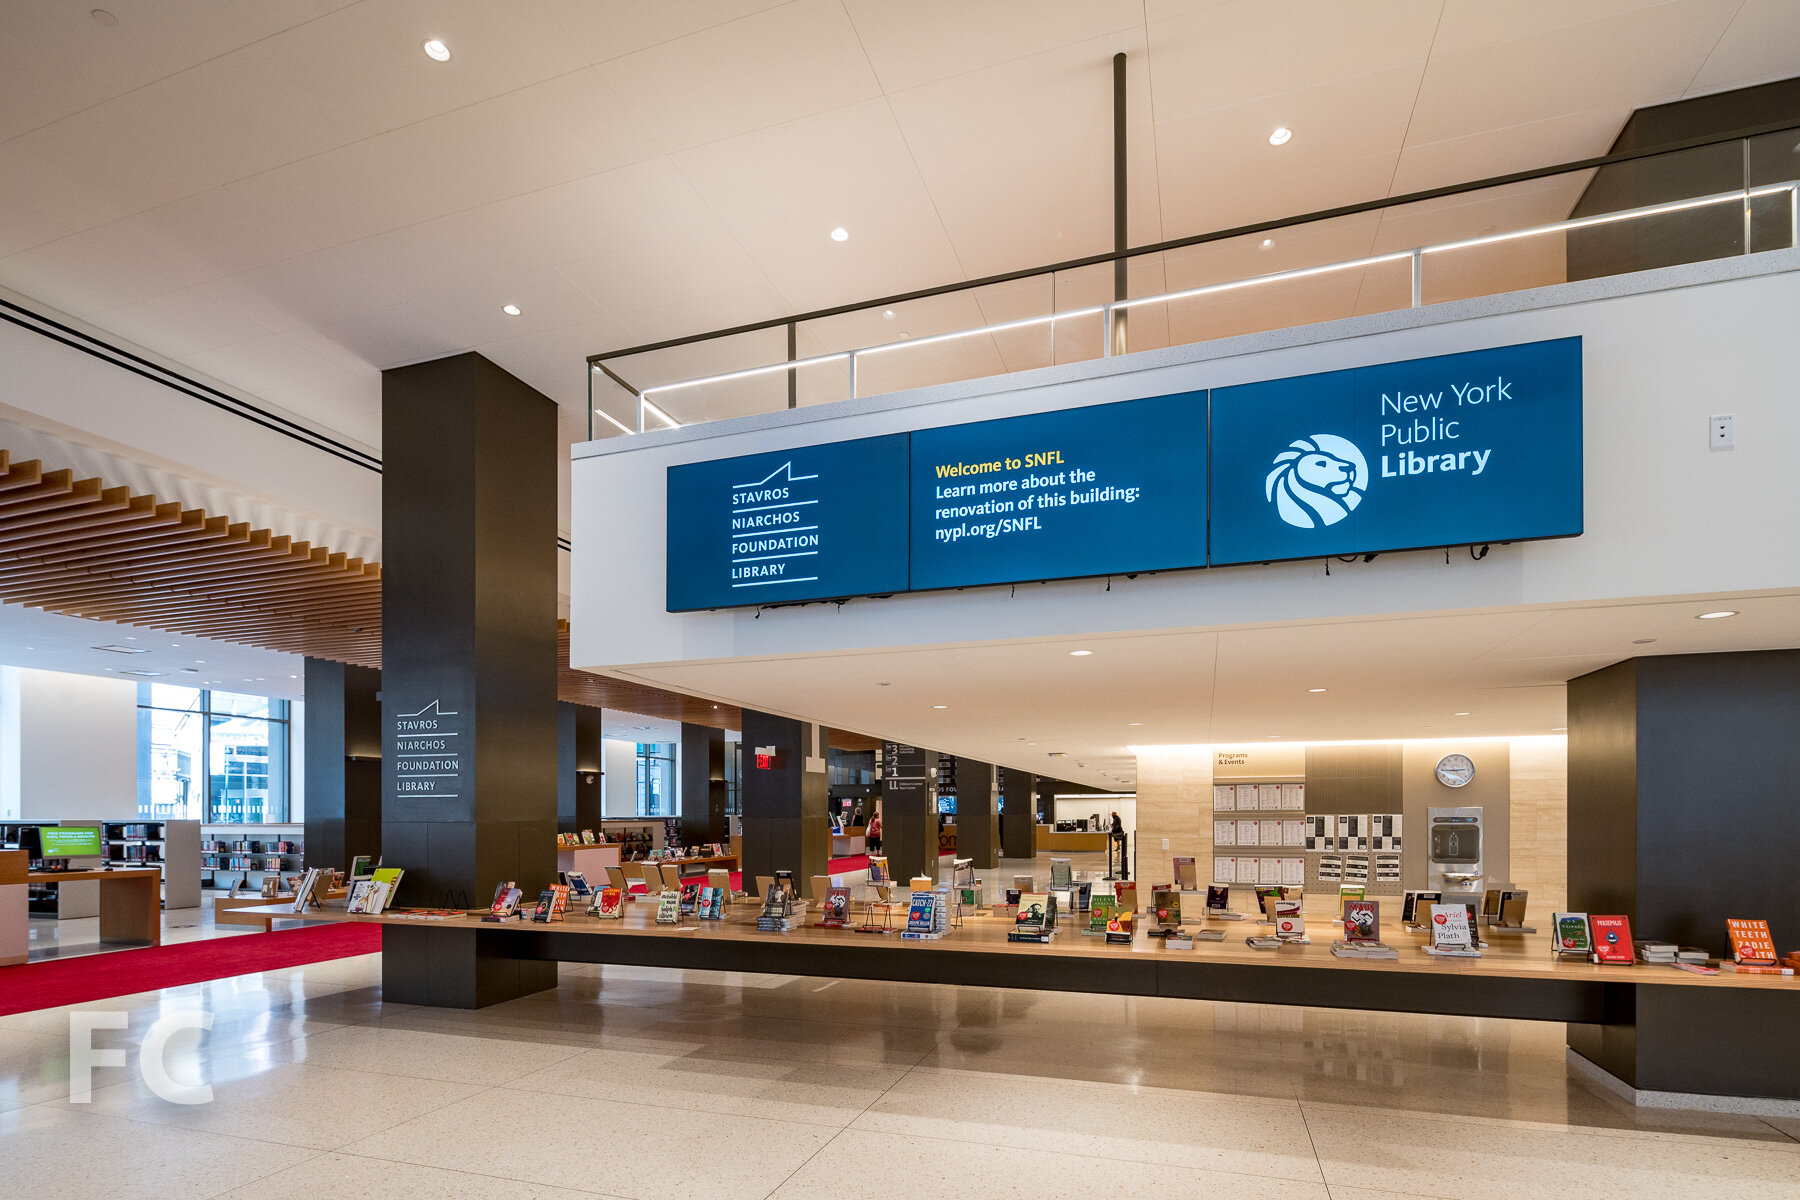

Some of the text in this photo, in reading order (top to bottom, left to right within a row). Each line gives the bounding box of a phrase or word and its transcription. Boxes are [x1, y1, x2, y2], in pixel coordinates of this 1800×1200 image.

[1382, 377, 1512, 415] New York
[1382, 417, 1459, 446] Public
[936, 450, 1064, 478] Welcome to SNFL
[1382, 449, 1492, 477] Library
[936, 468, 1095, 499] Learn more about the
[732, 487, 790, 505] STAVROS
[936, 486, 1140, 519] renovation of this building:
[732, 511, 800, 529] NIARCHOS
[936, 516, 1042, 542] nypl.org/SNFL
[732, 534, 818, 554] FOUNDATION
[732, 563, 786, 579] LIBRARY
[397, 720, 438, 730] STAVROS
[397, 740, 446, 750] NIARCHOS
[397, 760, 459, 771] FOUNDATION
[892, 756, 898, 766] 2
[892, 767, 899, 777] 1
[397, 781, 435, 791] LIBRARY
[1349, 903, 1375, 913] MAUS
[1442, 924, 1467, 932] Sylvia
[1731, 921, 1766, 929] WHITE
[1734, 930, 1768, 939] TEETH
